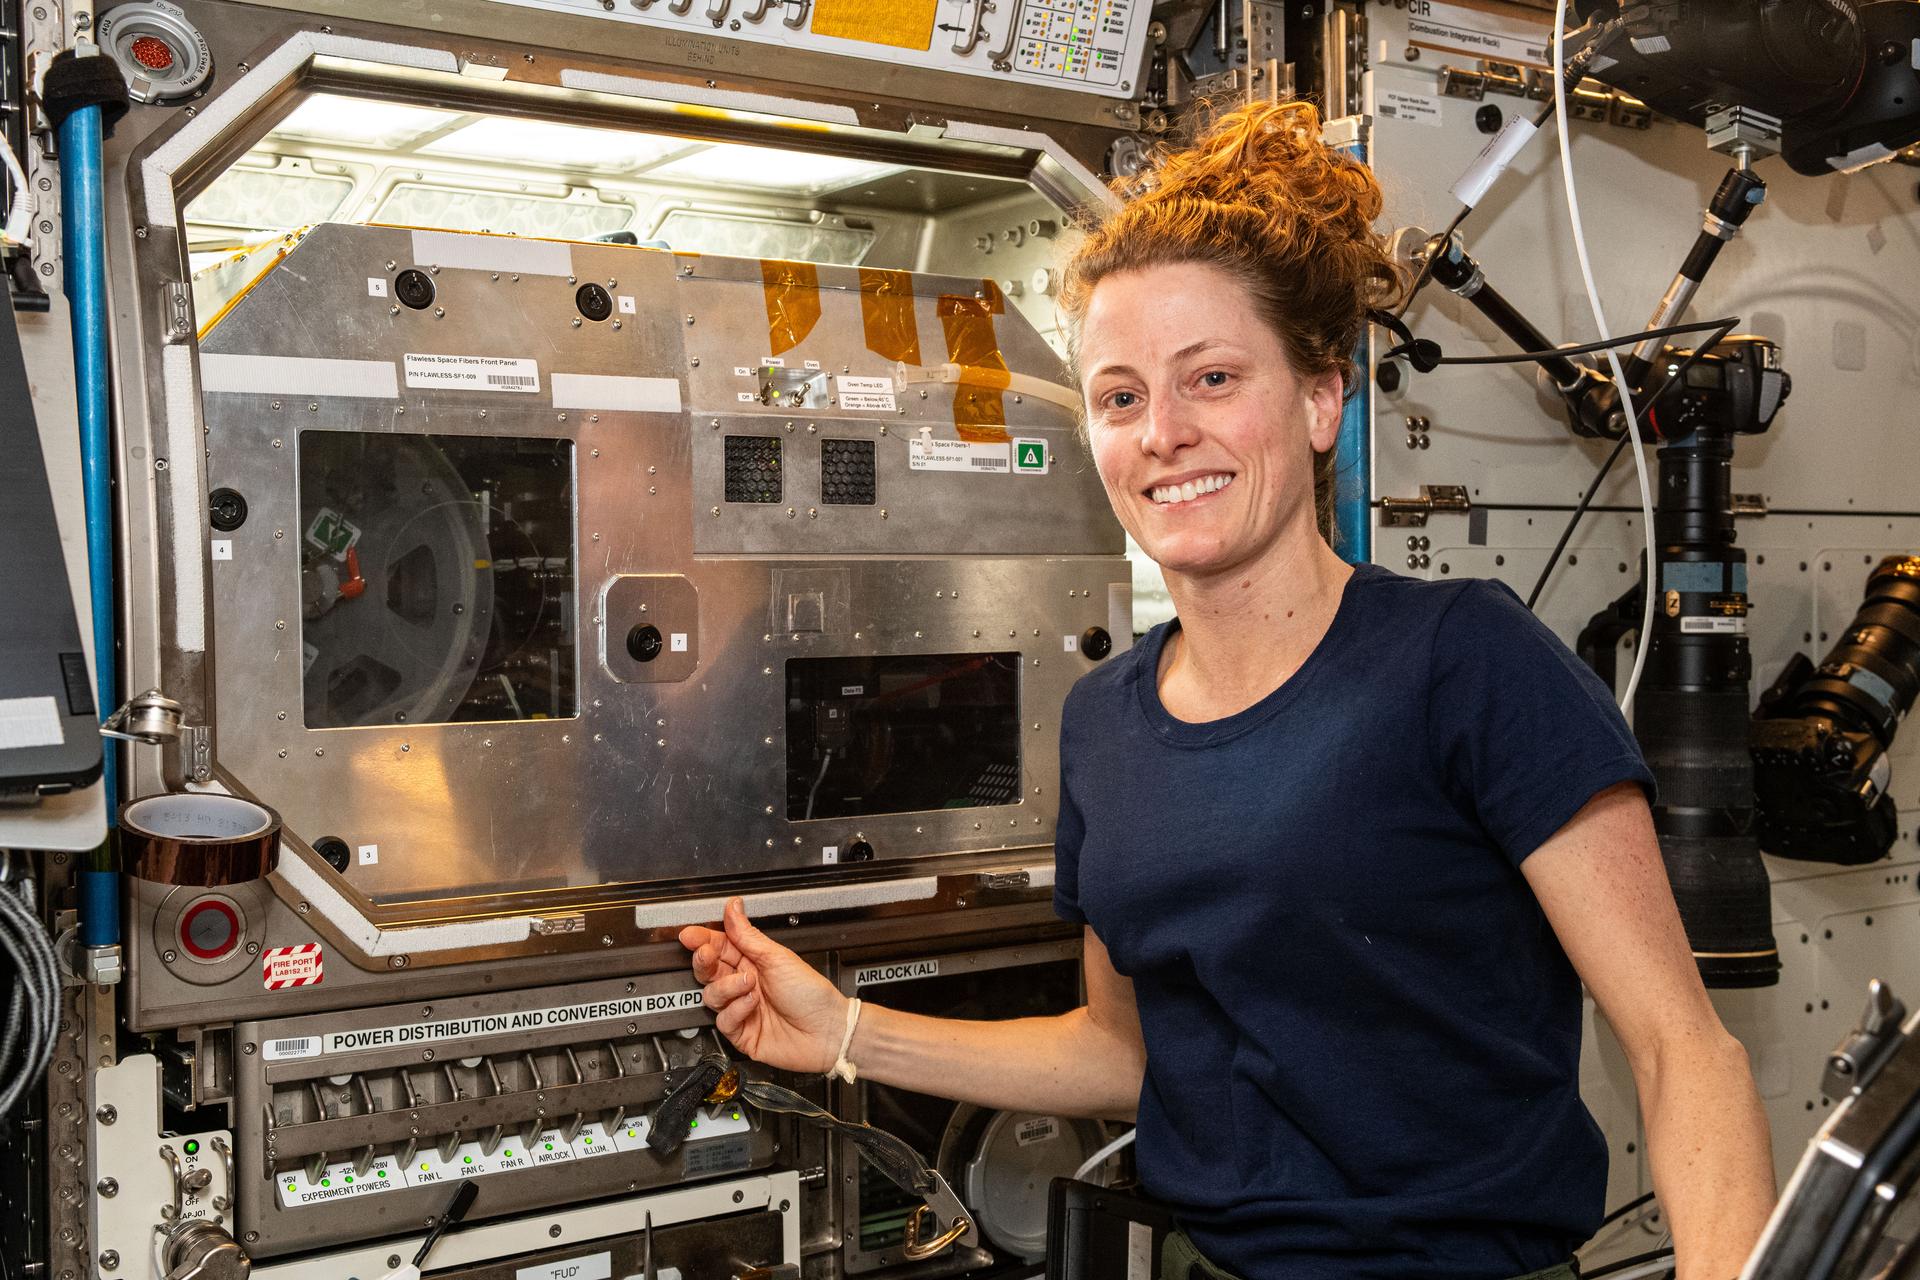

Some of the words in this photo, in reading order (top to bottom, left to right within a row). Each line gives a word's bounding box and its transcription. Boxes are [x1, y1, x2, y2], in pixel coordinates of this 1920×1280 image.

[1408, 0, 1431, 17] CIR
[1827, 0, 1857, 25] anon
[1449, 30, 1481, 44] Integrated
[688, 51, 715, 64] BEHIND
[406, 355, 436, 363] Flawless
[459, 357, 479, 365] Fibers
[480, 358, 498, 366] Front
[420, 372, 477, 380] FLAWLESS-SF1-009
[935, 441, 950, 449] Space
[273, 960, 290, 968] FIRE
[292, 958, 314, 966] PORT
[333, 1029, 394, 1050] POWER
[400, 1016, 508, 1041] DISTRIBUTION
[511, 1011, 543, 1029] AND
[546, 998, 642, 1024] CONVERSION
[646, 995, 676, 1011] BOX
[679, 991, 704, 1007] (PD
[539, 1135, 556, 1143] +28V
[583, 1145, 609, 1156] ILLUM.
[538, 1150, 570, 1163] AIRLOCK
[371, 1161, 389, 1170] +28V
[500, 1159, 518, 1169] FAN
[518, 1158, 525, 1166] R
[460, 1166, 477, 1176] FAN
[478, 1165, 485, 1173] C
[282, 1176, 296, 1184] +5V
[418, 1172, 435, 1182] FAN
[436, 1171, 443, 1180] L
[301, 1186, 355, 1202] EXPERIMENT
[356, 1180, 391, 1193] POWERS
[185, 1198, 200, 1206] OFF
[550, 1265, 580, 1280] "FUD"
